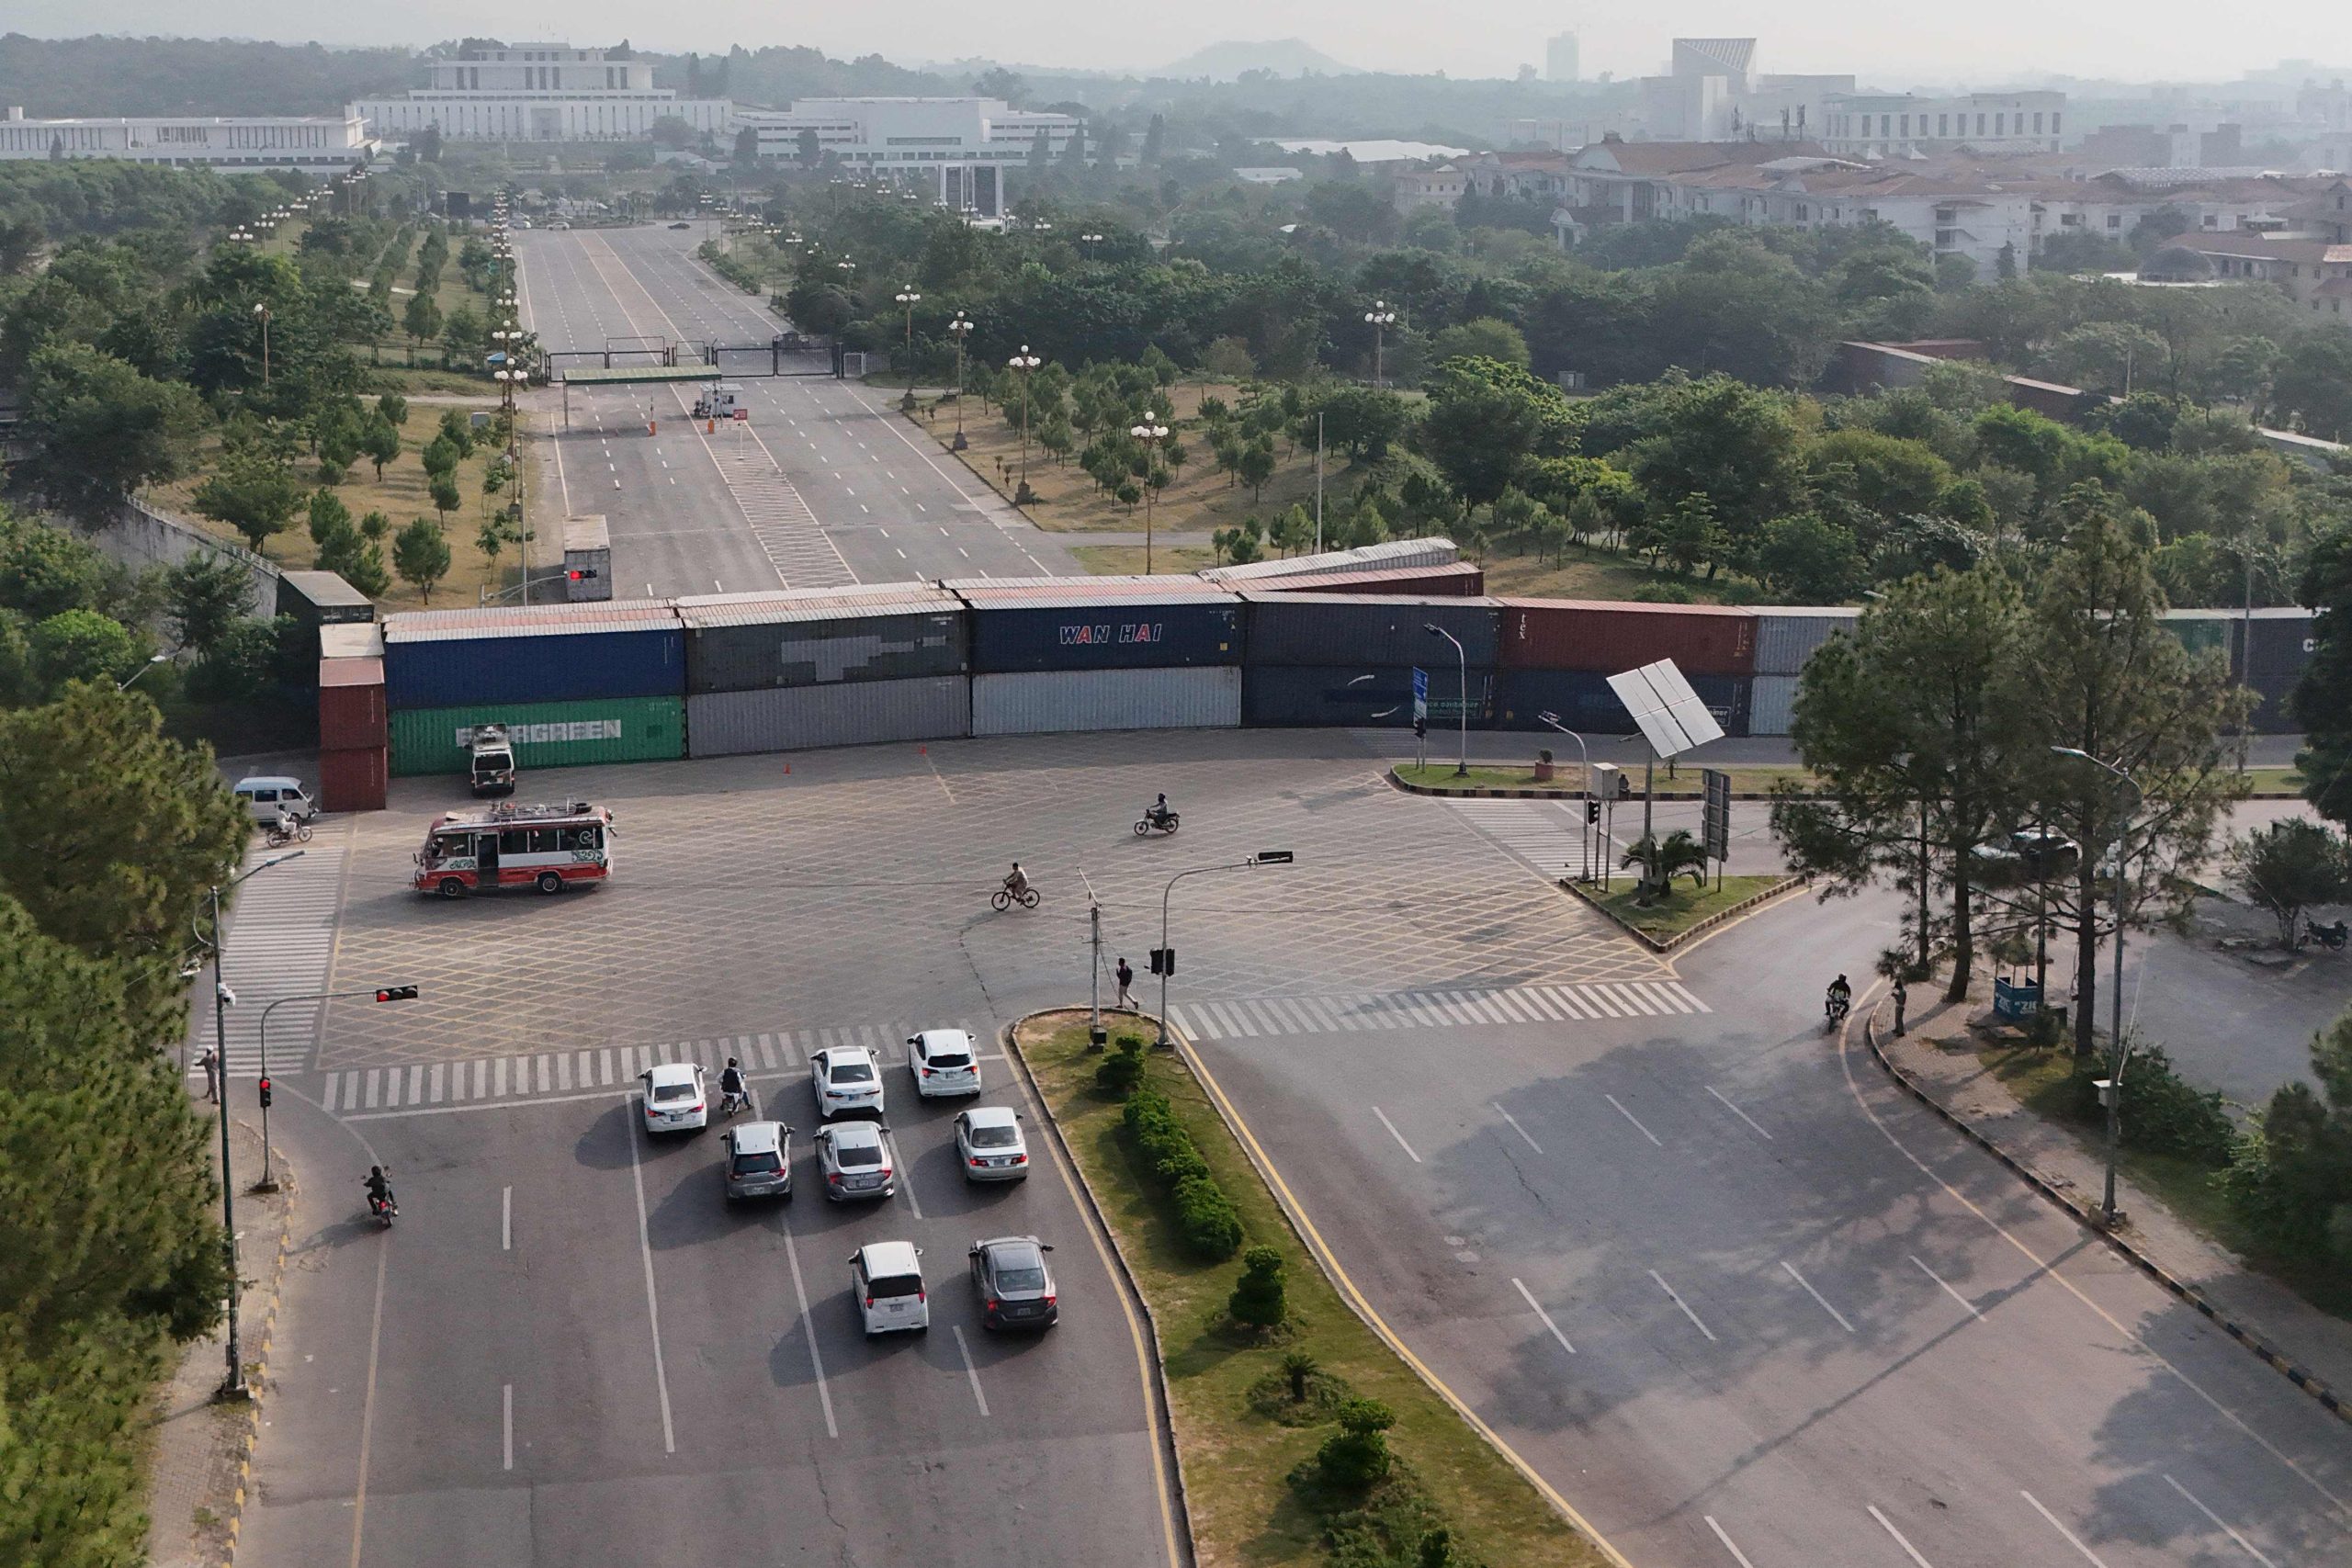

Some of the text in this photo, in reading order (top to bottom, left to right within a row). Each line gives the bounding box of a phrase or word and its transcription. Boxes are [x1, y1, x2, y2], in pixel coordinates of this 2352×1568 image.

[1059, 623, 1162, 645] WAN HAI
[456, 719, 622, 748] ERGREEN
